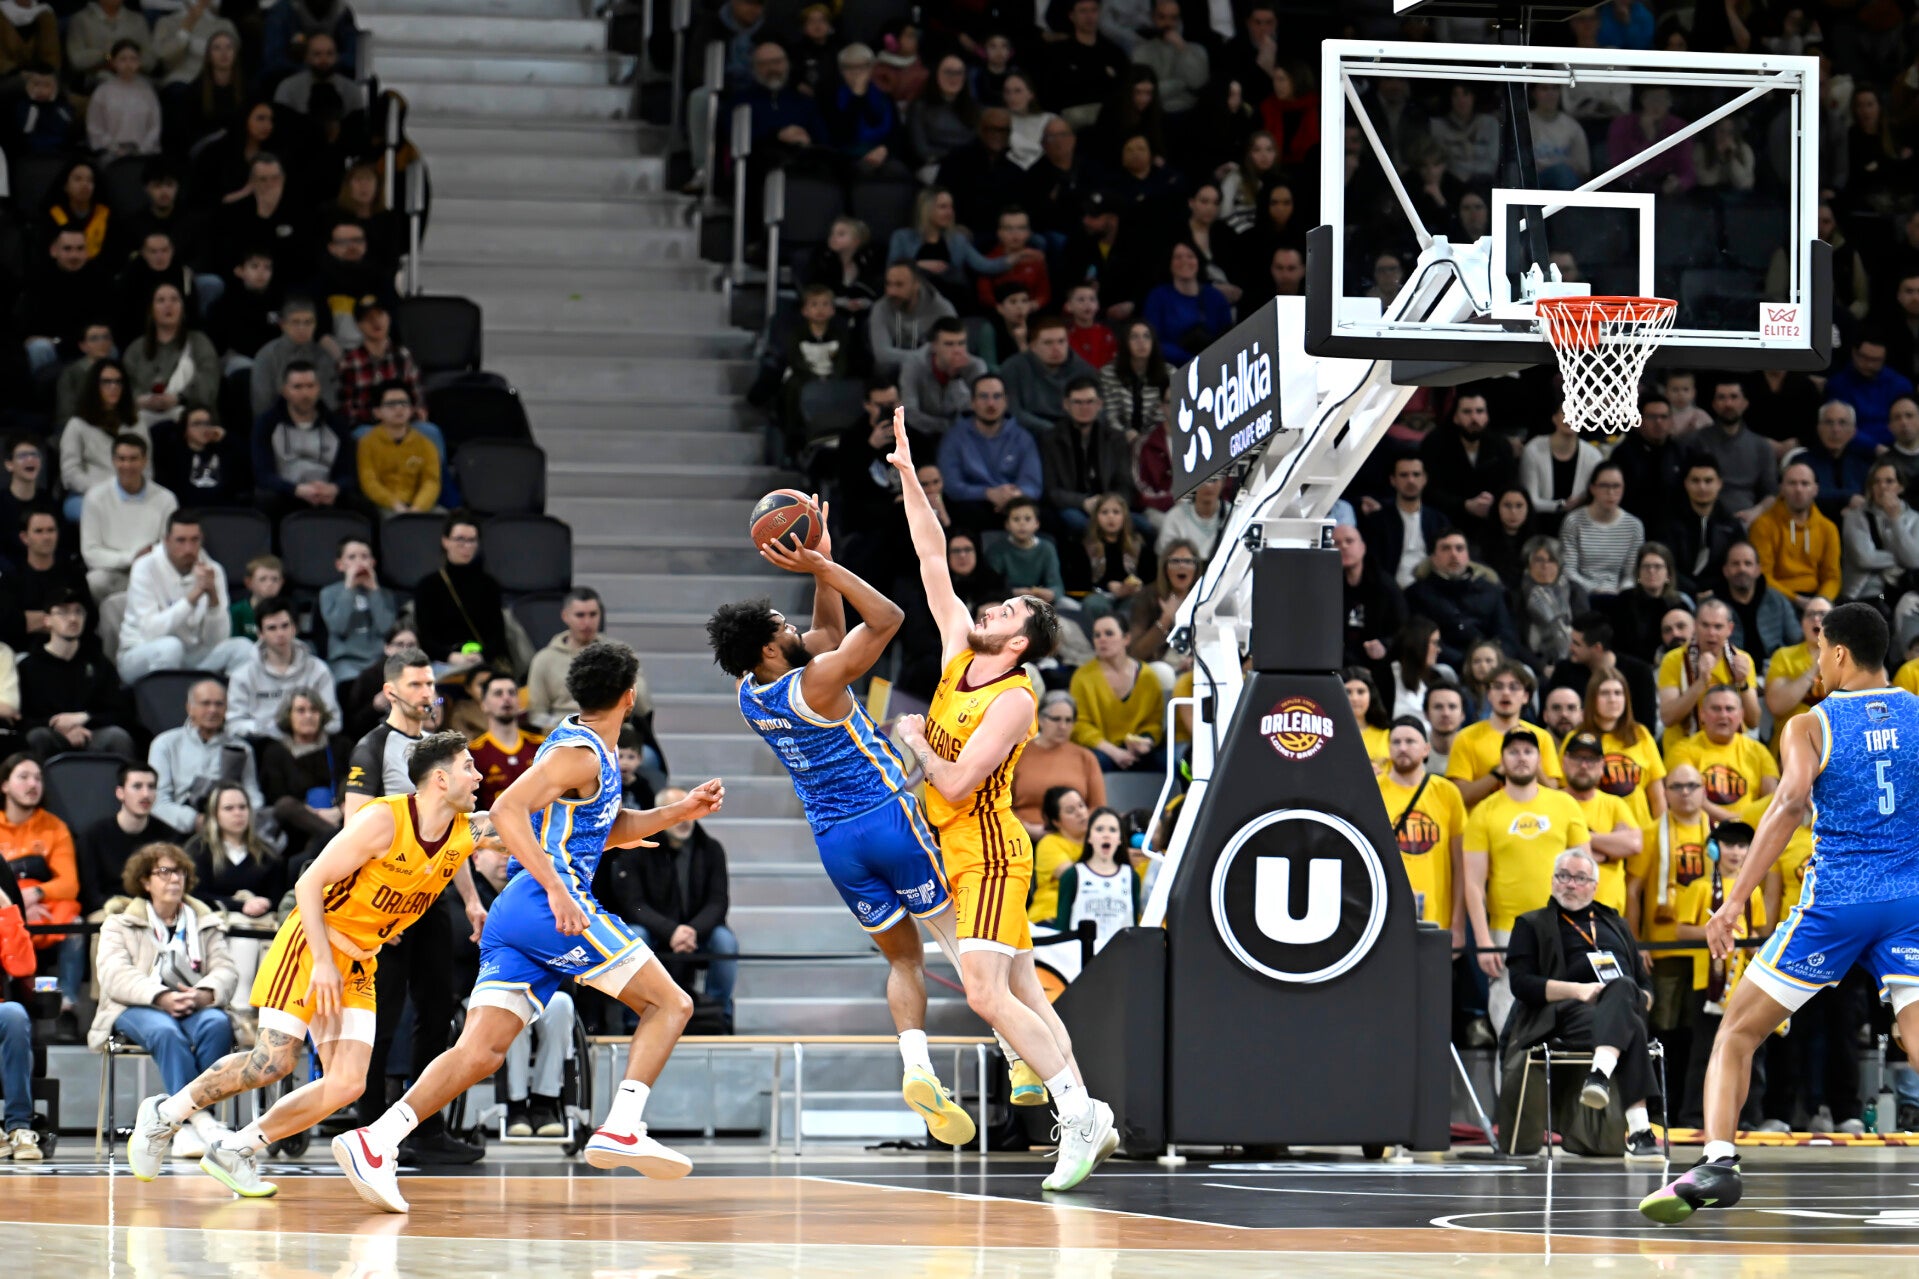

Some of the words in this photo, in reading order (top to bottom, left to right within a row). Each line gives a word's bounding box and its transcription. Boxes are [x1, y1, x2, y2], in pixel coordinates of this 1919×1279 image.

[1214, 341, 1272, 431] dalkia
[1230, 422, 1255, 457] GROUPE
[957, 712, 968, 724] U
[1863, 728, 1900, 752] TAPE
[1875, 760, 1896, 815] 5
[443, 868, 454, 878] U
[1254, 856, 1342, 945] U
